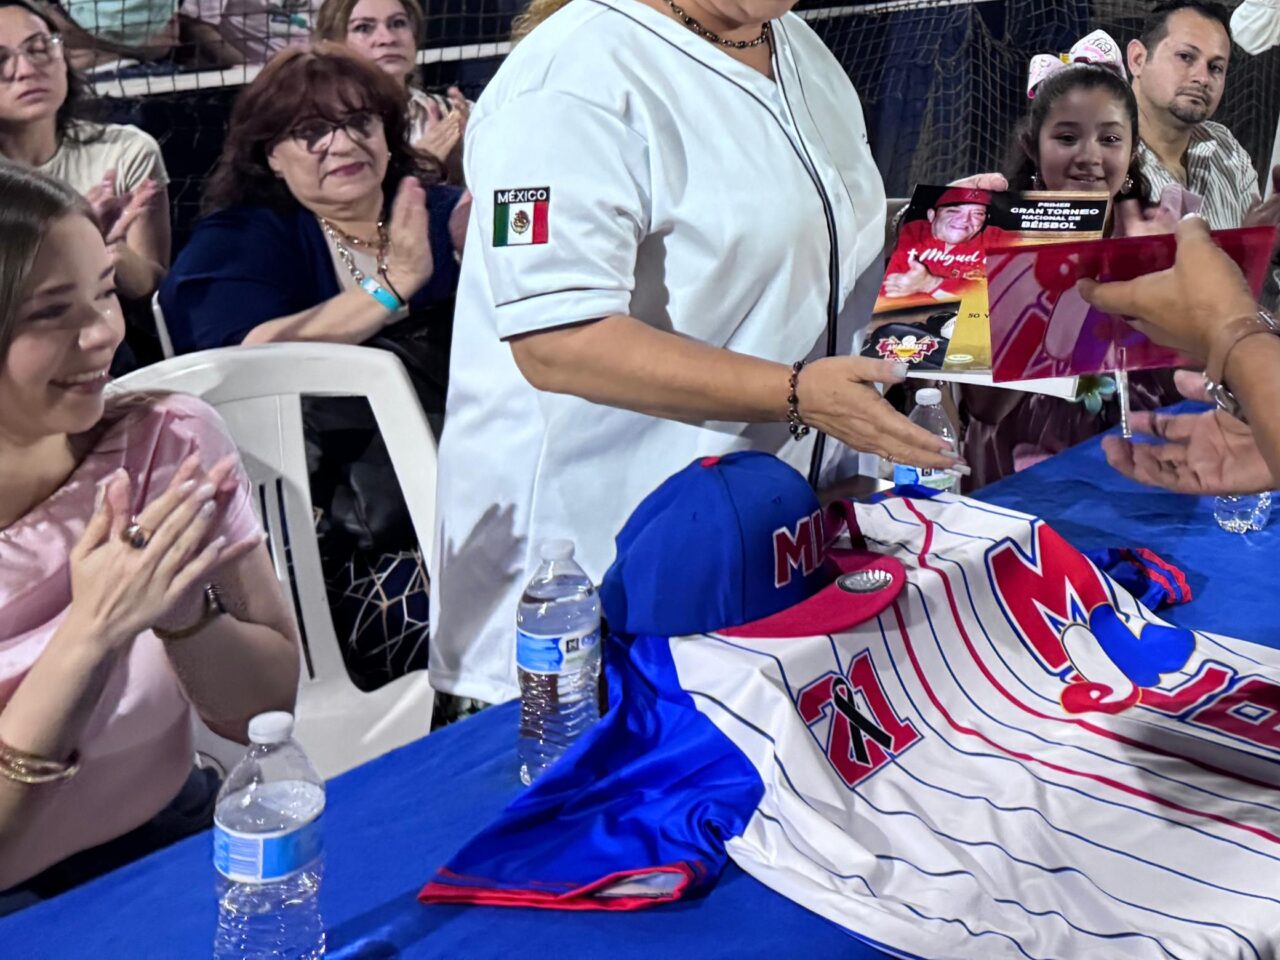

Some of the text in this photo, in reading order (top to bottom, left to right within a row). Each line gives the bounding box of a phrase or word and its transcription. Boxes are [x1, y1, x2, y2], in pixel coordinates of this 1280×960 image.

[497, 189, 547, 204] MÉXICO
[1021, 221, 1077, 229] BÉISBOL
[919, 247, 980, 266] Miguel
[795, 646, 922, 790] 21
